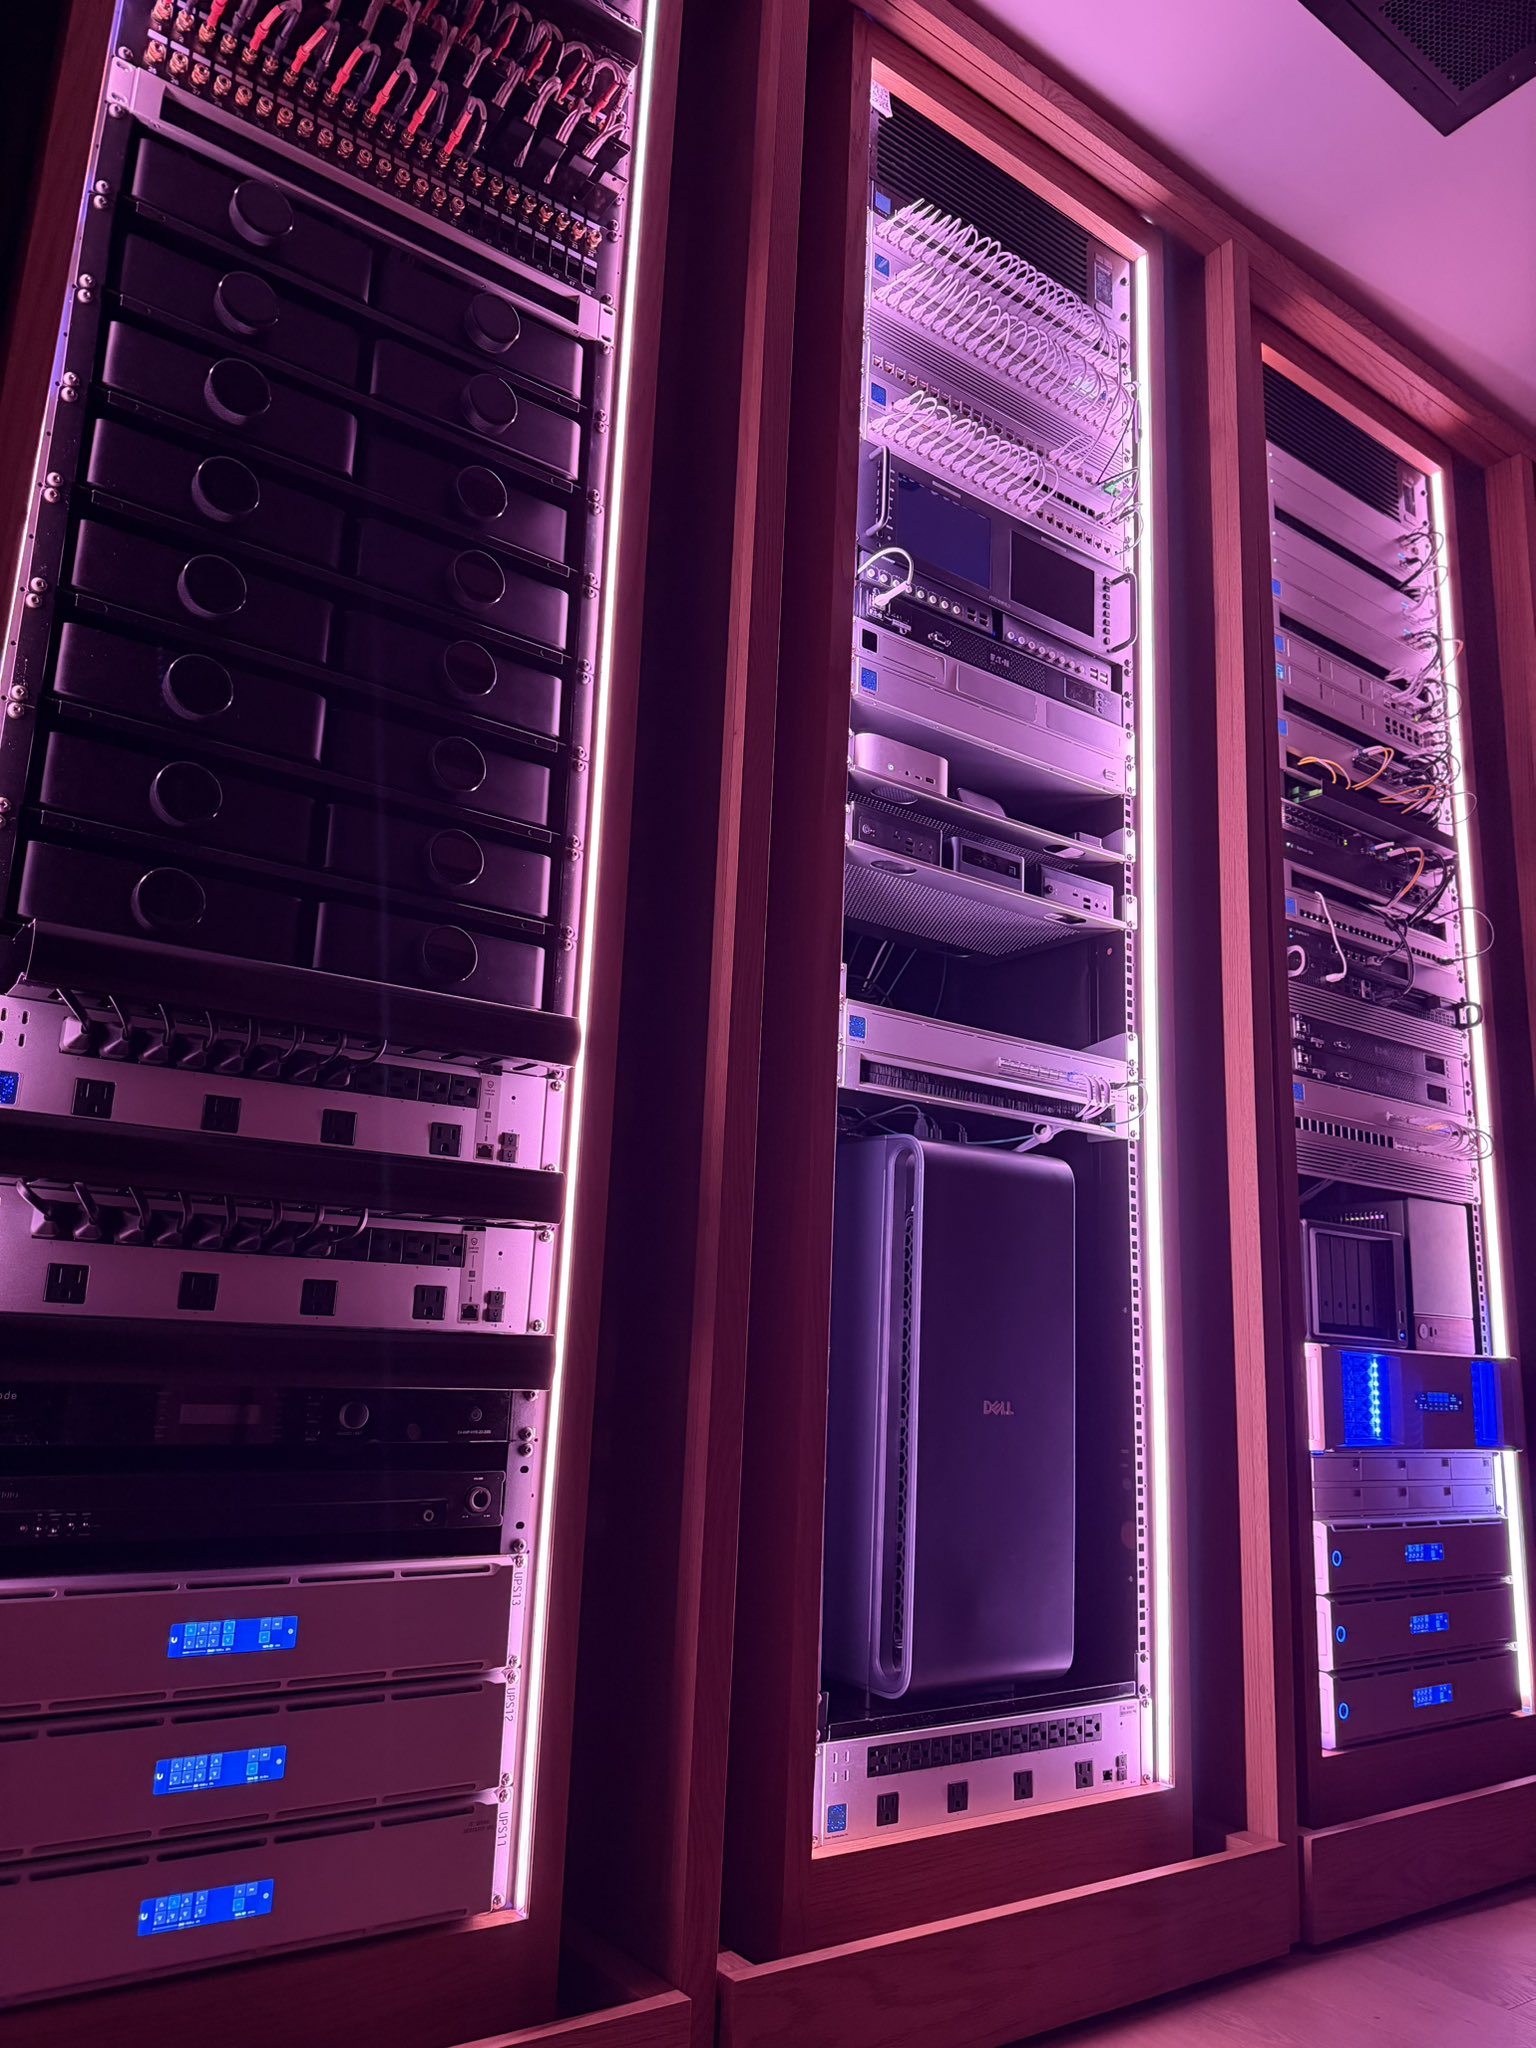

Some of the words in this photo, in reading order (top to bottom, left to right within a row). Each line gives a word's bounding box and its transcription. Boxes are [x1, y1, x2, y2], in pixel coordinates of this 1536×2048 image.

[983, 1400, 1015, 1415] DELL
[512, 1571, 523, 1606] UPS13
[505, 1687, 516, 1722] UPS12
[497, 1811, 509, 1847] UPS11
